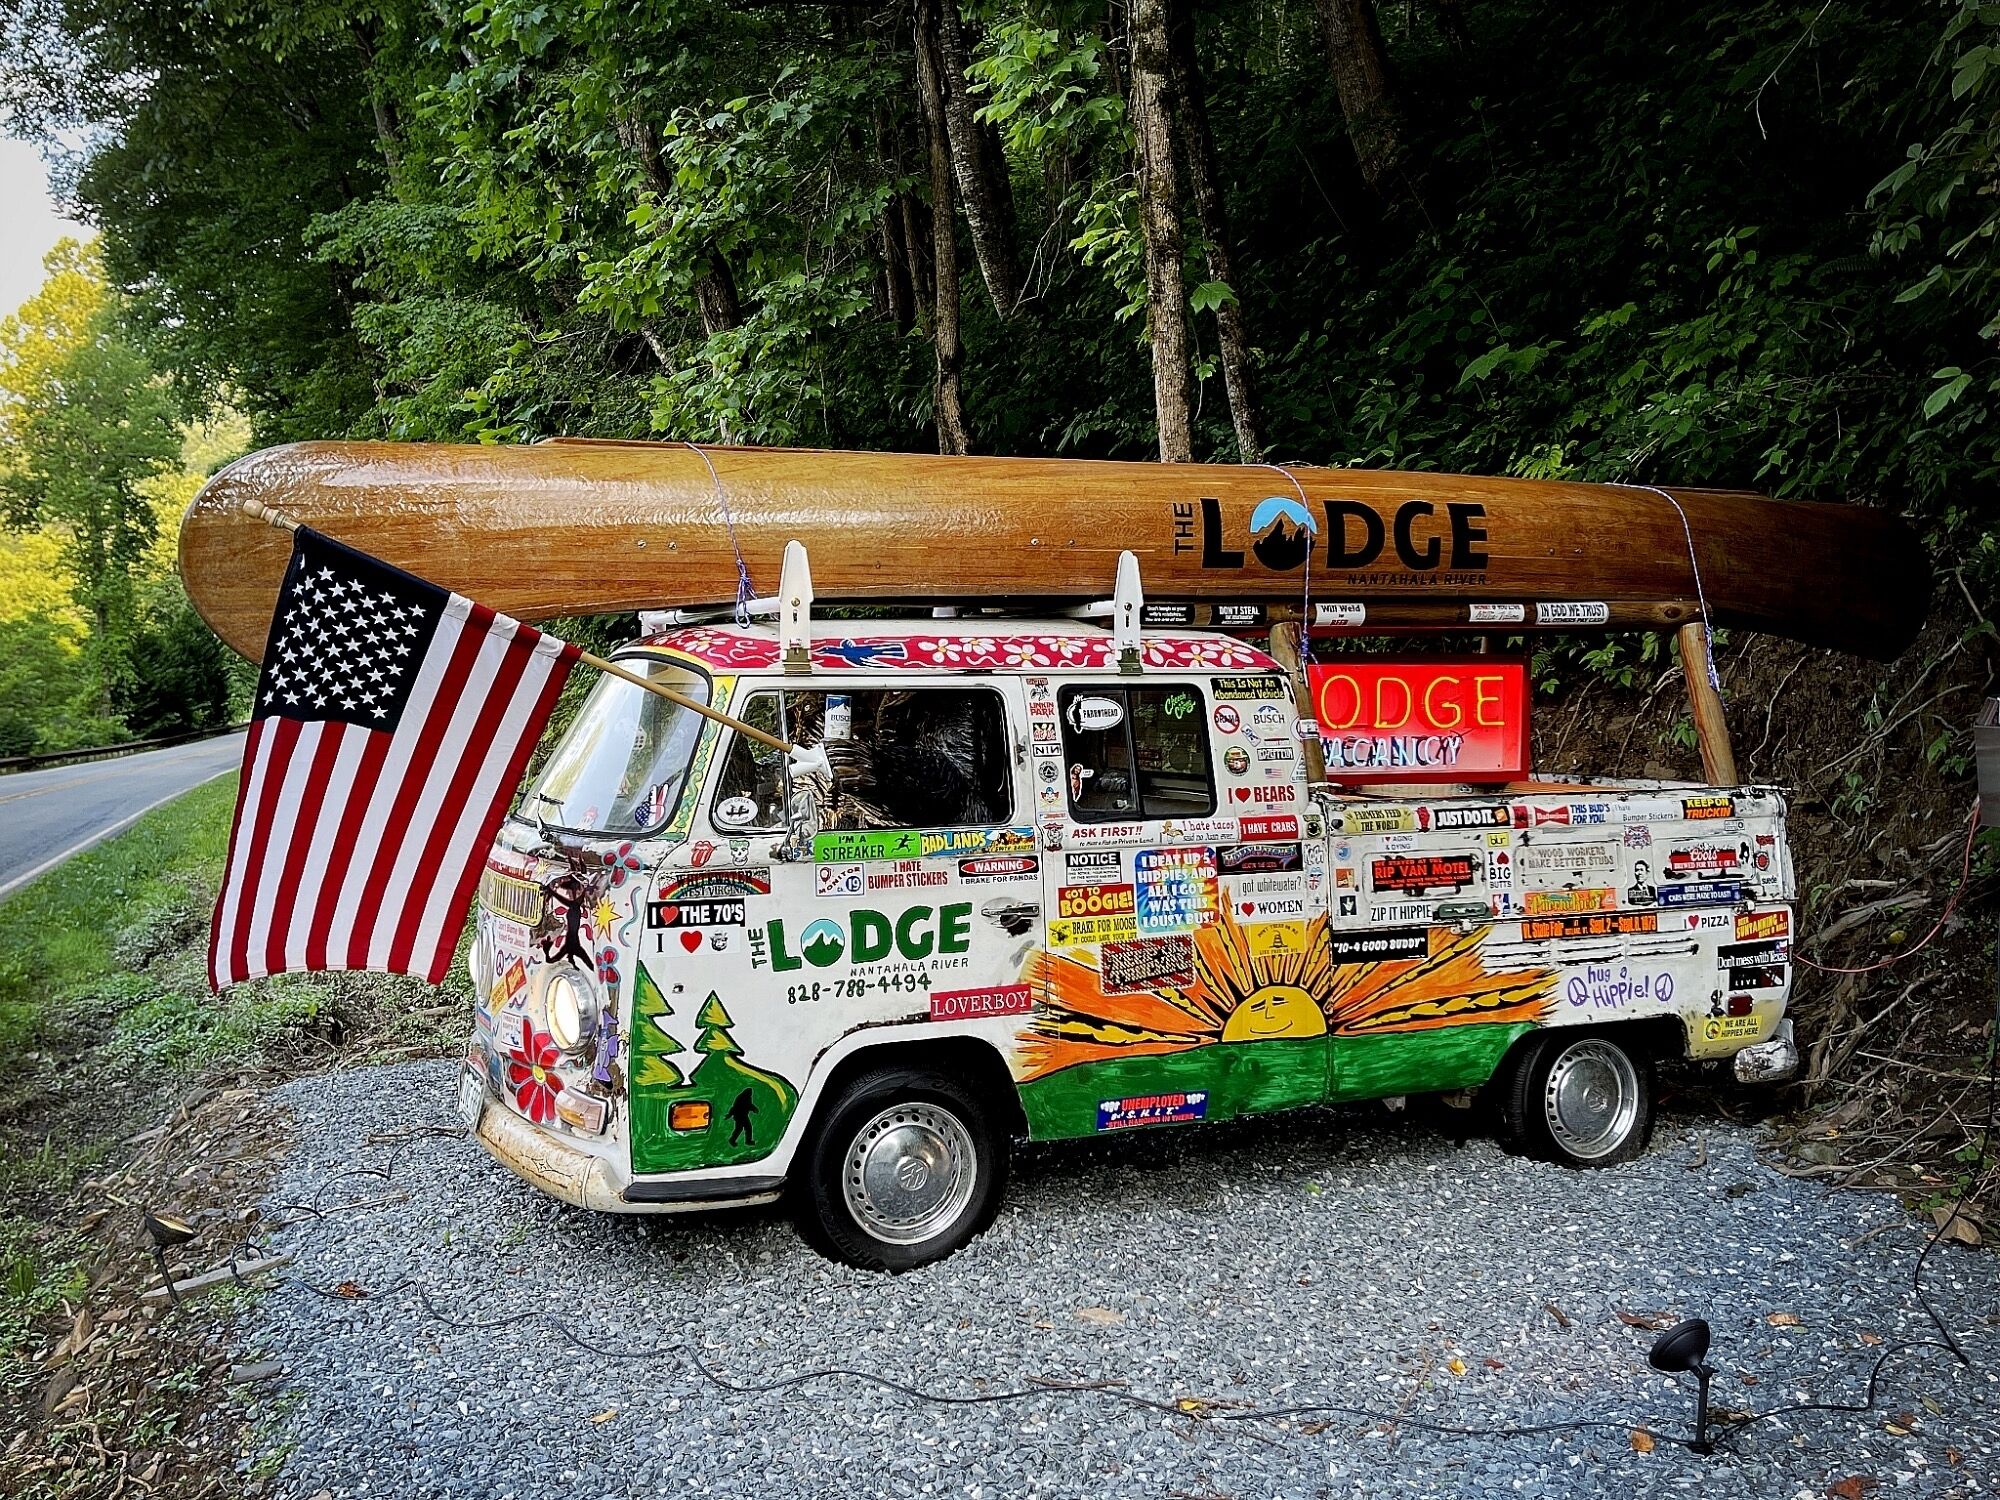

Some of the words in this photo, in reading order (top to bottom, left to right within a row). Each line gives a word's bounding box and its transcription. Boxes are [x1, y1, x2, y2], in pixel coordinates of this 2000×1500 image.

[1173, 503, 1194, 556] THE
[1200, 497, 1489, 571] LODGE
[1347, 573, 1437, 585] NANTAHALA
[1444, 574, 1487, 585] RIVER
[1219, 606, 1239, 615] DON'T
[1240, 606, 1260, 615] STEAL
[1339, 604, 1360, 612] Weld
[1540, 604, 1548, 618] IN
[1550, 604, 1567, 617] GOD
[1569, 605, 1580, 616] WE
[1582, 605, 1604, 616] TRUST
[1218, 680, 1236, 688] This
[1237, 679, 1247, 688] Is
[1248, 679, 1262, 688] Not
[1265, 679, 1276, 688] An
[1214, 688, 1256, 700] Abandoned
[1256, 689, 1285, 700] Vehicle
[1321, 674, 1505, 729] ODGE
[1030, 708, 1056, 718] PARK
[1254, 714, 1285, 724] BUSCH
[1322, 735, 1462, 767] ACANCY
[1228, 788, 1233, 804] I
[1254, 785, 1295, 802] BEARS
[1570, 804, 1587, 814] THIS
[1589, 804, 1610, 812] BUD'S
[1687, 798, 1713, 808] KEEP
[1716, 798, 1729, 806] ON
[1354, 810, 1384, 820] FARMERS
[1386, 808, 1401, 818] FEED
[1437, 812, 1461, 826] JUST
[1462, 811, 1478, 824] DO
[1572, 815, 1588, 824] FOR
[1622, 814, 1647, 822] Bumper
[1648, 812, 1674, 820] Stickers
[1072, 828, 1096, 838] ASK
[1100, 826, 1144, 837] FIRST!!
[1182, 821, 1188, 832] I
[1189, 820, 1210, 832] hate
[1212, 820, 1234, 830] tacos
[1248, 822, 1268, 834] HAVE
[1271, 821, 1296, 833] CRABS
[1361, 822, 1374, 832] THE
[1376, 820, 1400, 830] WORLD
[838, 836, 854, 844] I'M
[859, 835, 866, 843] A
[921, 831, 986, 856] BADLANDS
[1490, 836, 1507, 846] blur
[822, 844, 885, 862] STREAKER
[1488, 852, 1494, 865] I
[1539, 849, 1564, 858] WOOD
[1567, 846, 1606, 856] WORKERS
[1690, 848, 1718, 860] Coors
[894, 862, 898, 873] I
[900, 860, 922, 872] HATE
[974, 860, 1024, 872] WARNING
[1070, 853, 1117, 866] NOTICE
[1150, 854, 1182, 867] BEAT
[1184, 853, 1199, 866] UP
[1528, 860, 1552, 868] MAKE
[1554, 858, 1586, 868] BETTER
[1588, 856, 1614, 866] STUDS
[1138, 869, 1188, 884] HIPPIES
[1191, 867, 1216, 880] AND
[1374, 866, 1395, 878] RIP
[1400, 864, 1428, 876] VAN
[1432, 862, 1471, 874] MOTEL
[1490, 866, 1512, 880] BIG
[818, 866, 861, 894] MONITOR
[848, 878, 860, 892] 19
[868, 874, 906, 890] BUMPER
[906, 871, 948, 888] STICKERS
[1010, 874, 1038, 882] PANDAS
[1762, 875, 1778, 884] suede
[1065, 888, 1084, 898] GOT
[1087, 886, 1100, 896] TO
[1148, 884, 1170, 898] ALL
[1180, 882, 1205, 896] GOT
[1243, 880, 1254, 896] got
[1257, 876, 1302, 892] whitewater?
[1060, 892, 1134, 917] BOOGIE!
[1149, 900, 1177, 913] WAS
[1180, 898, 1208, 910] THIS
[1235, 904, 1240, 916] I
[1258, 900, 1303, 915] WOMEN
[652, 908, 656, 926] I
[680, 905, 710, 924] THE
[714, 904, 744, 922] 70'S
[1142, 914, 1181, 928] LOUSY
[1186, 911, 1214, 924] BUS!
[1371, 908, 1386, 922] ZIP
[1389, 906, 1398, 920] IT
[1400, 904, 1433, 920] HIPPIE
[1072, 922, 1095, 934] BRAKE
[1098, 920, 1112, 932] FOR
[1114, 917, 1136, 930] MOOSE
[1701, 915, 1730, 928] PIZZA
[656, 933, 664, 953] I
[767, 902, 973, 972] LODGE
[1362, 940, 1388, 950] GOOD
[1390, 938, 1426, 948] BUDDY"
[748, 928, 768, 968] THE
[1718, 956, 1735, 968] Don't
[1736, 955, 1754, 967] mess
[1754, 951, 1770, 964] with
[1768, 950, 1788, 963] Texas
[850, 962, 926, 978] NANTAHALA
[931, 958, 969, 971] RIVER
[1588, 966, 1610, 984] hug
[1620, 966, 1628, 979] a
[787, 972, 932, 1005] 828-788-4494
[1735, 978, 1757, 987] LIVE
[1592, 975, 1649, 1009] Hippie!
[932, 990, 1029, 1017] LOVERBOY
[1736, 1018, 1747, 1027] ARE
[1747, 1018, 1758, 1026] ALL
[1721, 1028, 1744, 1038] HIPPIES
[1744, 1026, 1759, 1036] HERE
[1122, 1094, 1186, 1111] UNEMPLOYED
[1171, 1113, 1194, 1122] THERE
